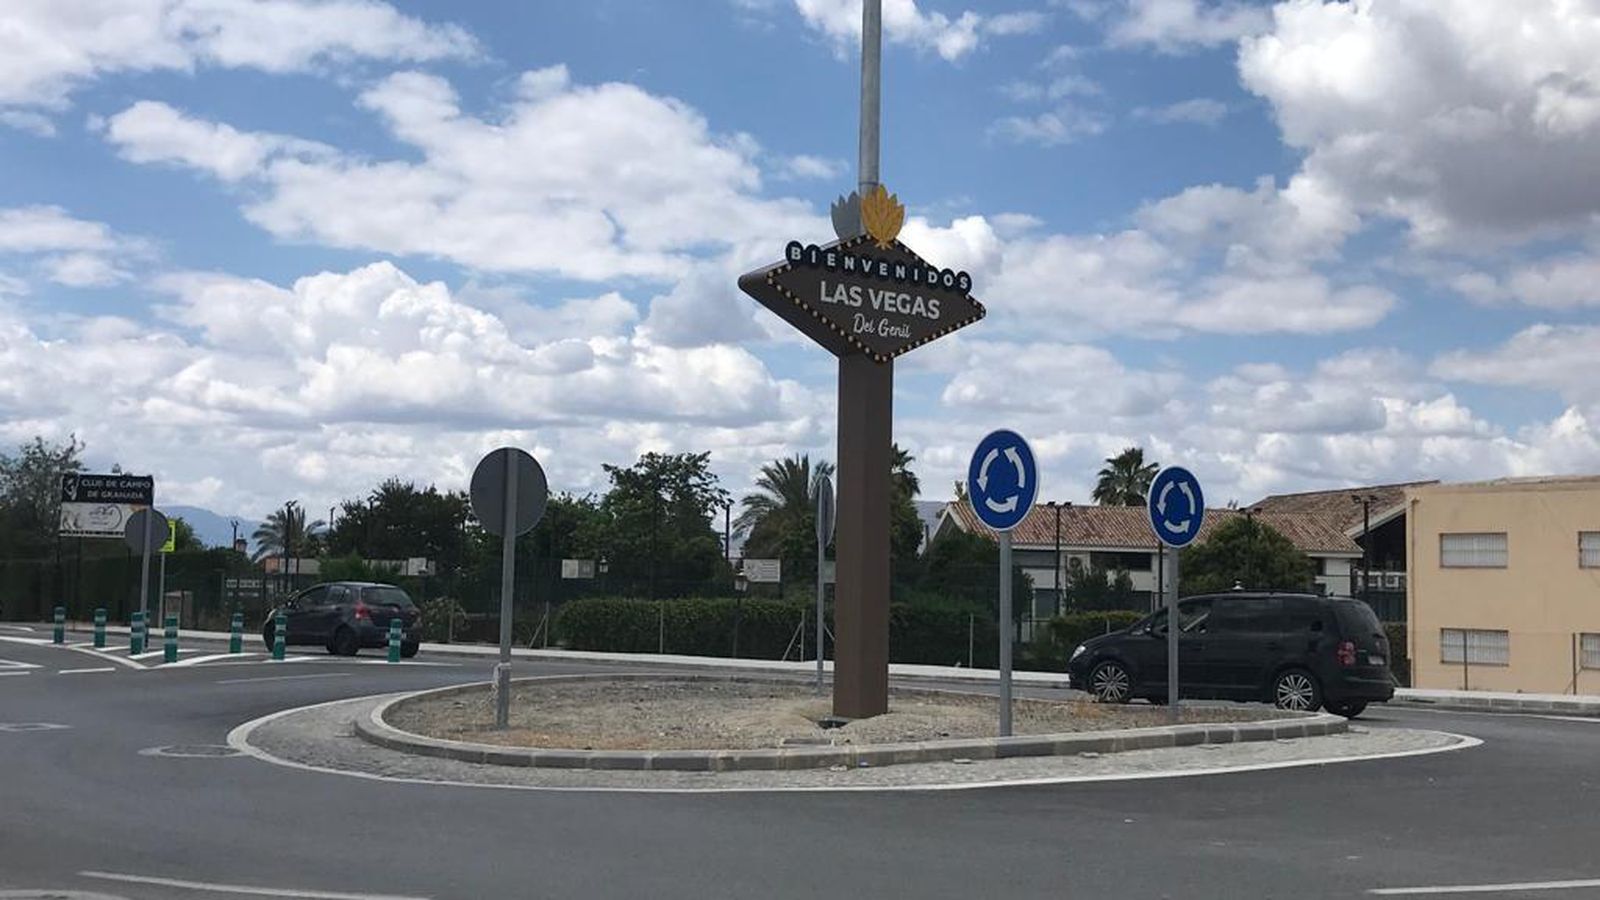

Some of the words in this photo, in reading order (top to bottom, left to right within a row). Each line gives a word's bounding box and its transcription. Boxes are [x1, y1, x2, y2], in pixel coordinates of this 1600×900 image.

[790, 246, 969, 290] BIENVENIDOS
[820, 280, 862, 307] LAS
[868, 288, 940, 320] VEGAS
[853, 313, 874, 333] Del
[878, 318, 911, 338] Genil
[105, 479, 117, 488] DE
